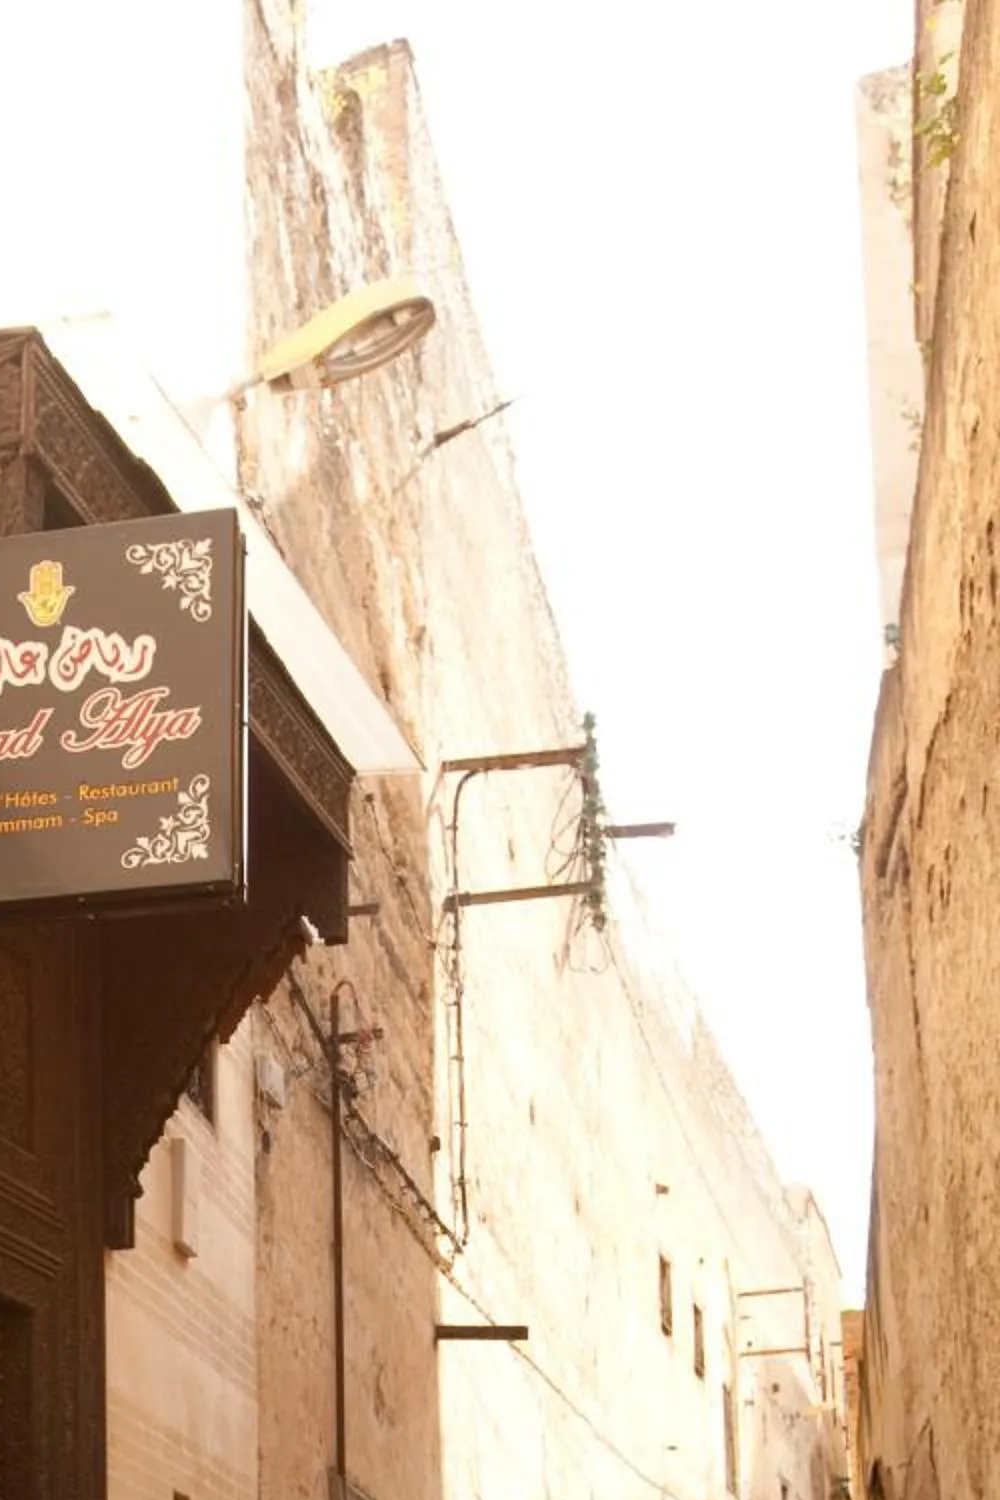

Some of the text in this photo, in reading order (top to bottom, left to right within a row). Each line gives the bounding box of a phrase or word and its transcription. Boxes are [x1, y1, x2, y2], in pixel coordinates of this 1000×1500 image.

[51, 625, 155, 691] رياض
[60, 687, 201, 769] Alya
[78, 777, 180, 801] Restaurant
[83, 808, 119, 828] Spa
